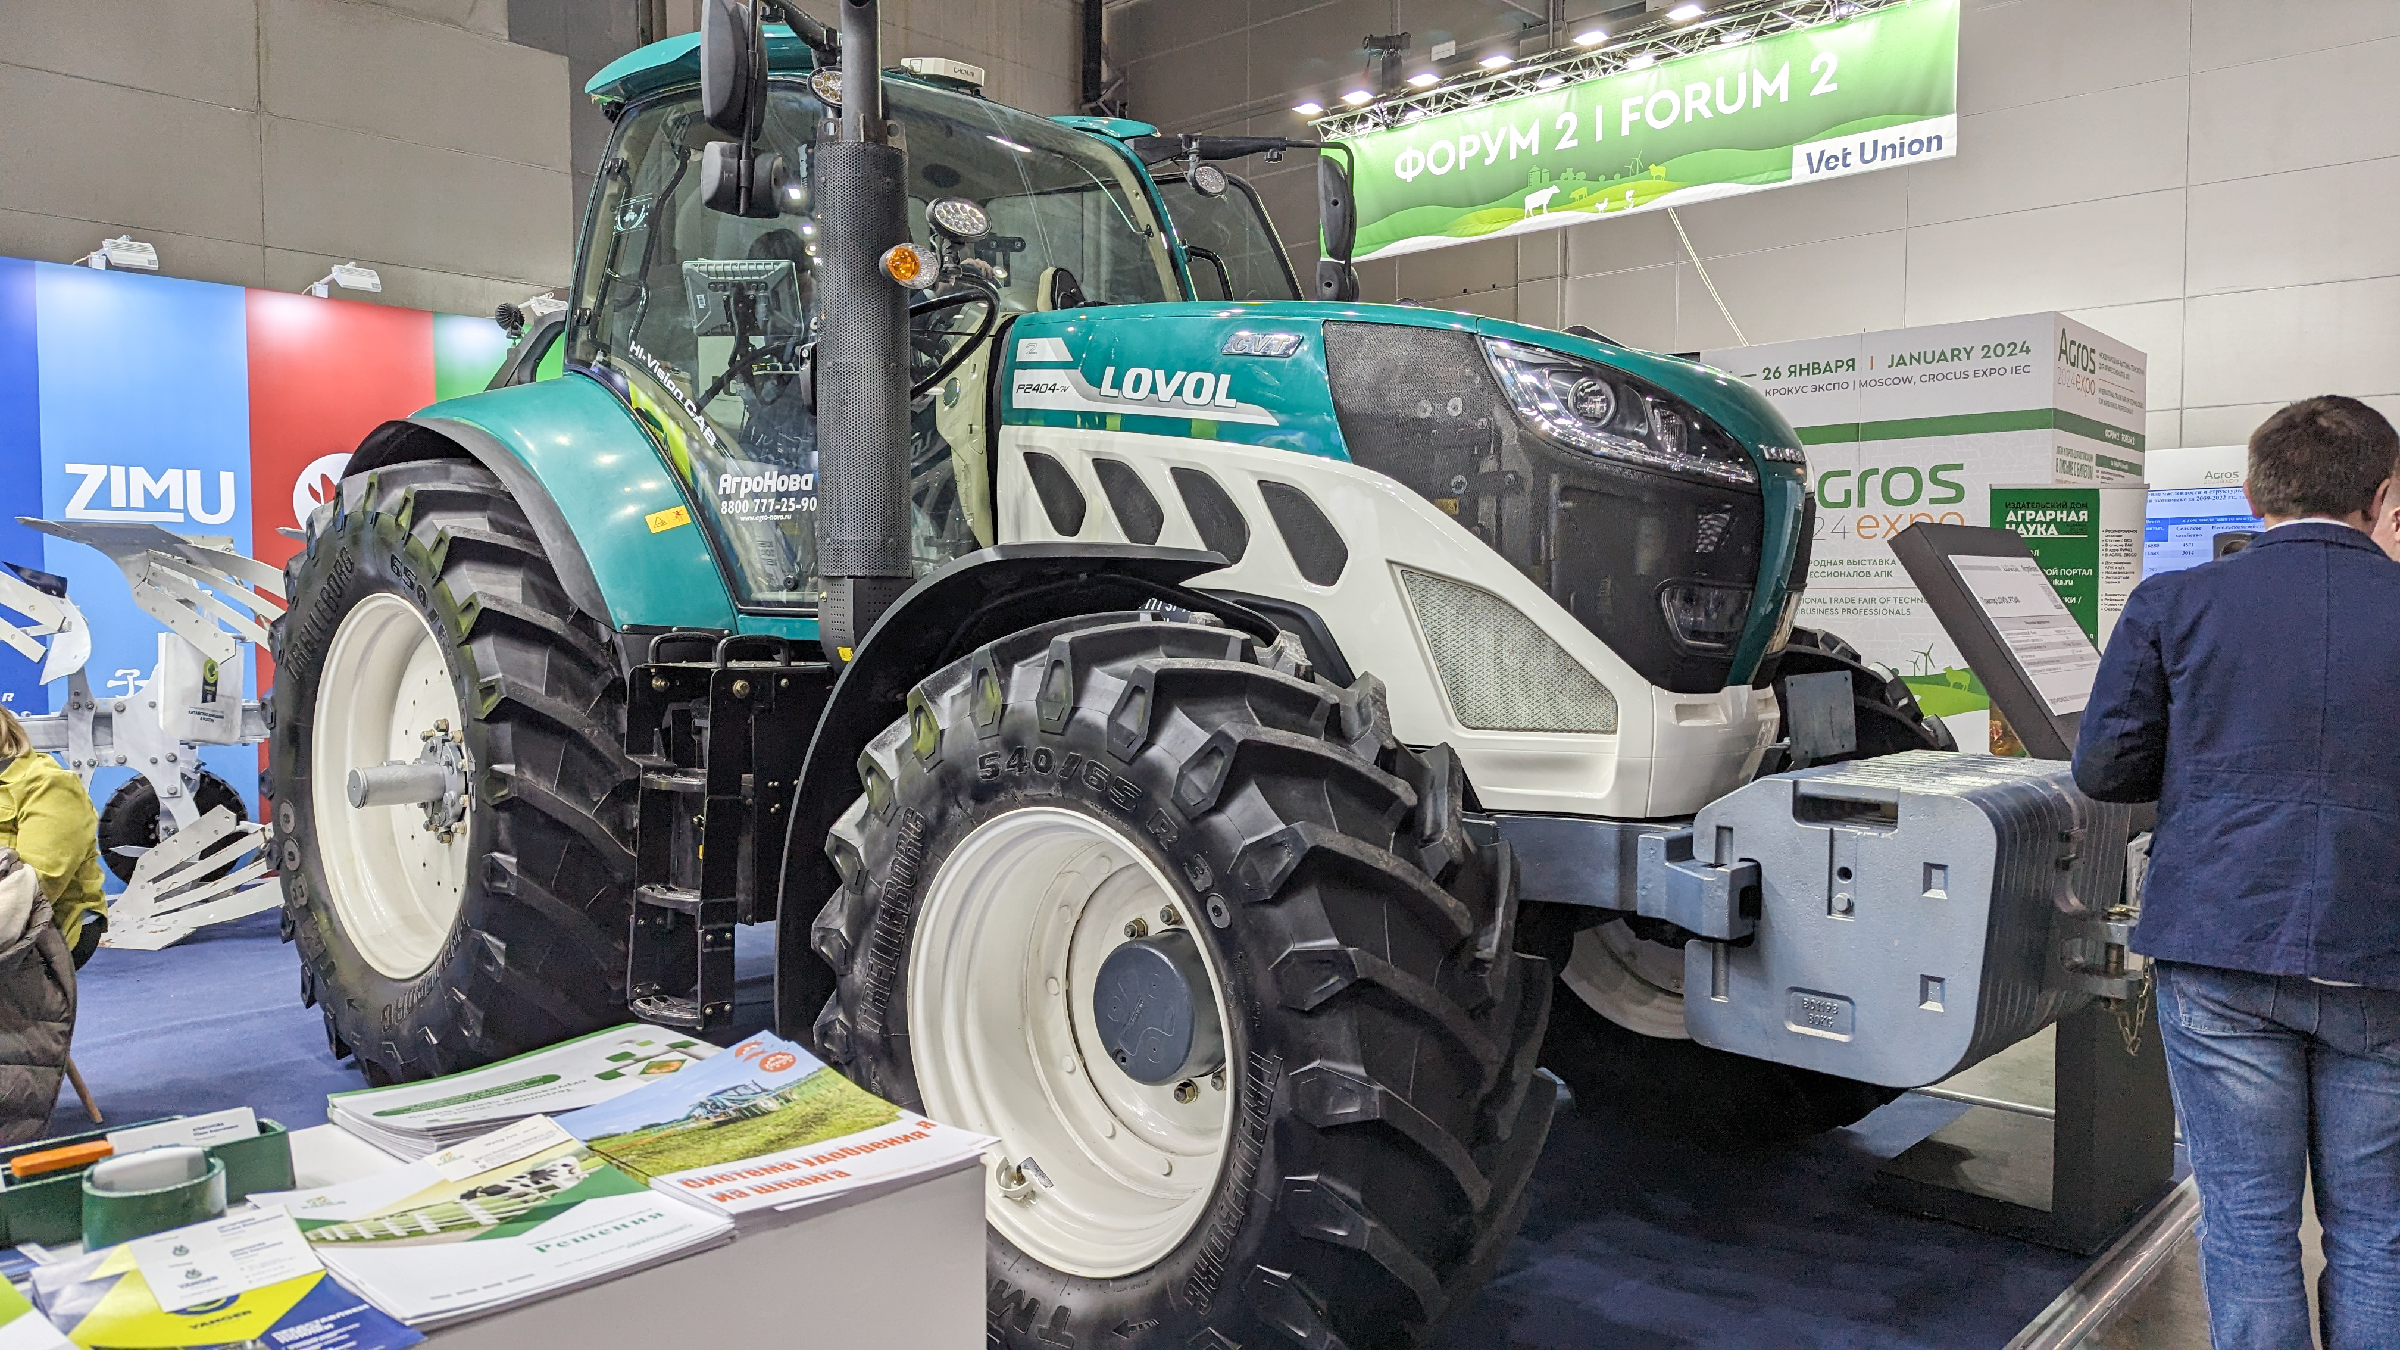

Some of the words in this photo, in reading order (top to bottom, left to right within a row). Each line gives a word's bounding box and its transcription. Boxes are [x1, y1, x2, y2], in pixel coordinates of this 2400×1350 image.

[1394, 119, 1540, 183] ФОРУМ
[1555, 111, 1578, 151] 2
[1621, 61, 1790, 137] FORUM
[1810, 52, 1840, 96] 2
[1806, 148, 1852, 175] Vet
[1860, 131, 1943, 165] Union
[1231, 335, 1290, 354] CVT
[1762, 366, 1782, 381] 26
[1787, 357, 1856, 380] ЯНВАРЯ
[1888, 346, 1975, 369] JANUARY
[1981, 340, 2031, 360] 2024
[1100, 366, 1237, 408] LOVOL
[1764, 385, 1808, 397] КРОКУС
[1810, 381, 1849, 394] ЭКСПО
[1858, 375, 1916, 390] MOSCOW,
[1919, 371, 1970, 384] CROCUS
[1973, 367, 2007, 379] EXPO
[2010, 364, 2031, 376] IEC
[684, 397, 718, 447] CAB
[64, 463, 236, 525] ZIMU
[718, 470, 815, 498] АгроНова
[720, 499, 749, 515] 8800
[753, 497, 818, 514] 777-25-90
[2005, 500, 2069, 510] ИЗДАТЕЛЬСКИЙ
[2070, 501, 2088, 511] ДОМ
[2005, 510, 2088, 522] АГРАРНАЯ
[2005, 523, 2058, 536] НАУКА
[1846, 558, 1897, 567] ВЫСТАВКА
[1874, 570, 1893, 578] АПК
[2060, 568, 2093, 577] ПОРТАЛ
[1800, 608, 1840, 617] BUSINESS
[1841, 607, 1911, 617] PROFESSIONALS
[1829, 597, 1856, 605] TRADE
[1858, 597, 1877, 605] FAIR
[1879, 597, 1892, 605] OF
[977, 745, 1142, 812] 540/65
[1145, 807, 1181, 852] R
[858, 806, 927, 1034] TRELLEBORG
[1184, 1050, 1284, 1317] TRELLEBORG
